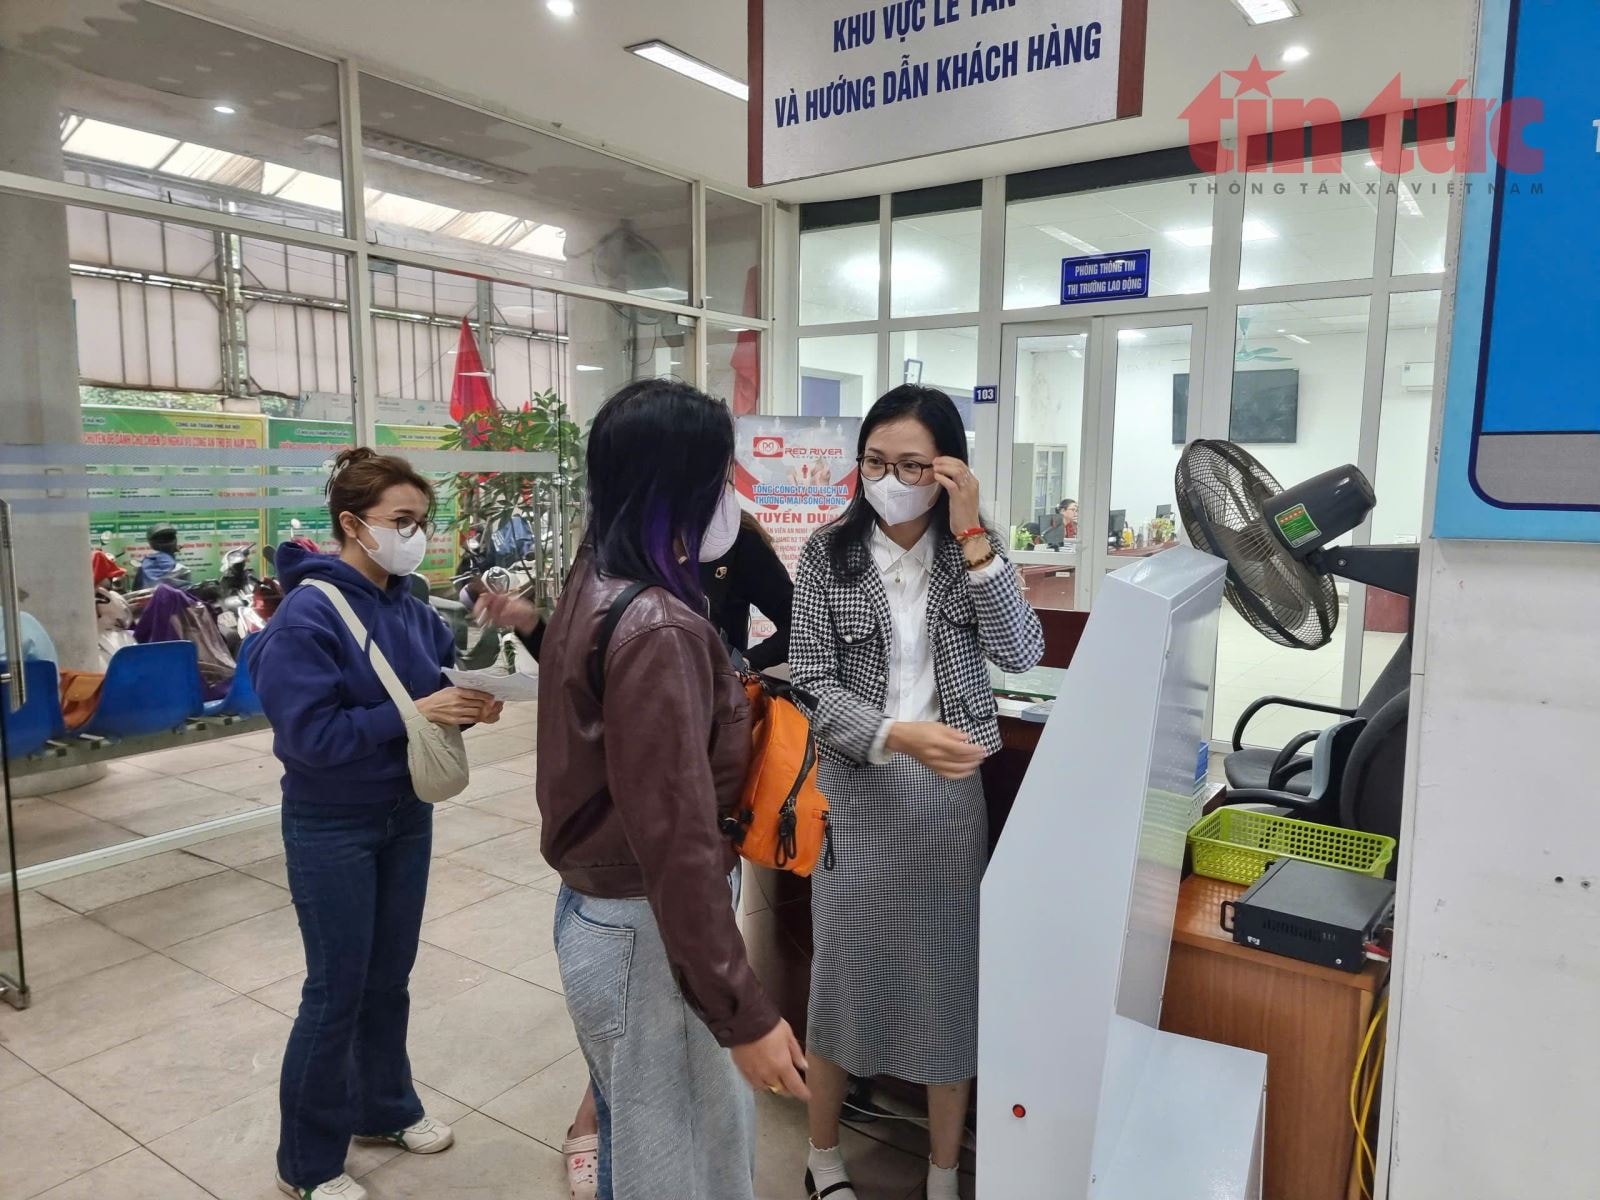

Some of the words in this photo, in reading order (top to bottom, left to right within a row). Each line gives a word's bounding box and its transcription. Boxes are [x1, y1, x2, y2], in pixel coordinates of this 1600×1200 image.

[833, 10, 876, 53] KHU
[883, 0, 925, 43] VỰC
[775, 88, 799, 128] VÀ
[805, 75, 876, 122] HƯỚNG
[882, 54, 930, 106] DẪN
[936, 41, 1018, 93] KHÁCH
[1027, 22, 1102, 72] HÀNG
[1074, 262, 1098, 276] PHÒNG
[1100, 260, 1122, 274] THÔNG
[1124, 260, 1136, 272] TIN
[1067, 284, 1079, 296] THỊ
[1107, 280, 1121, 292] LAO
[976, 389, 994, 400] 103
[785, 447, 807, 456] RED
[810, 448, 842, 456] RIVER
[797, 486, 806, 494] TY
[807, 486, 818, 494] DU
[755, 509, 802, 523] TUYỂN
